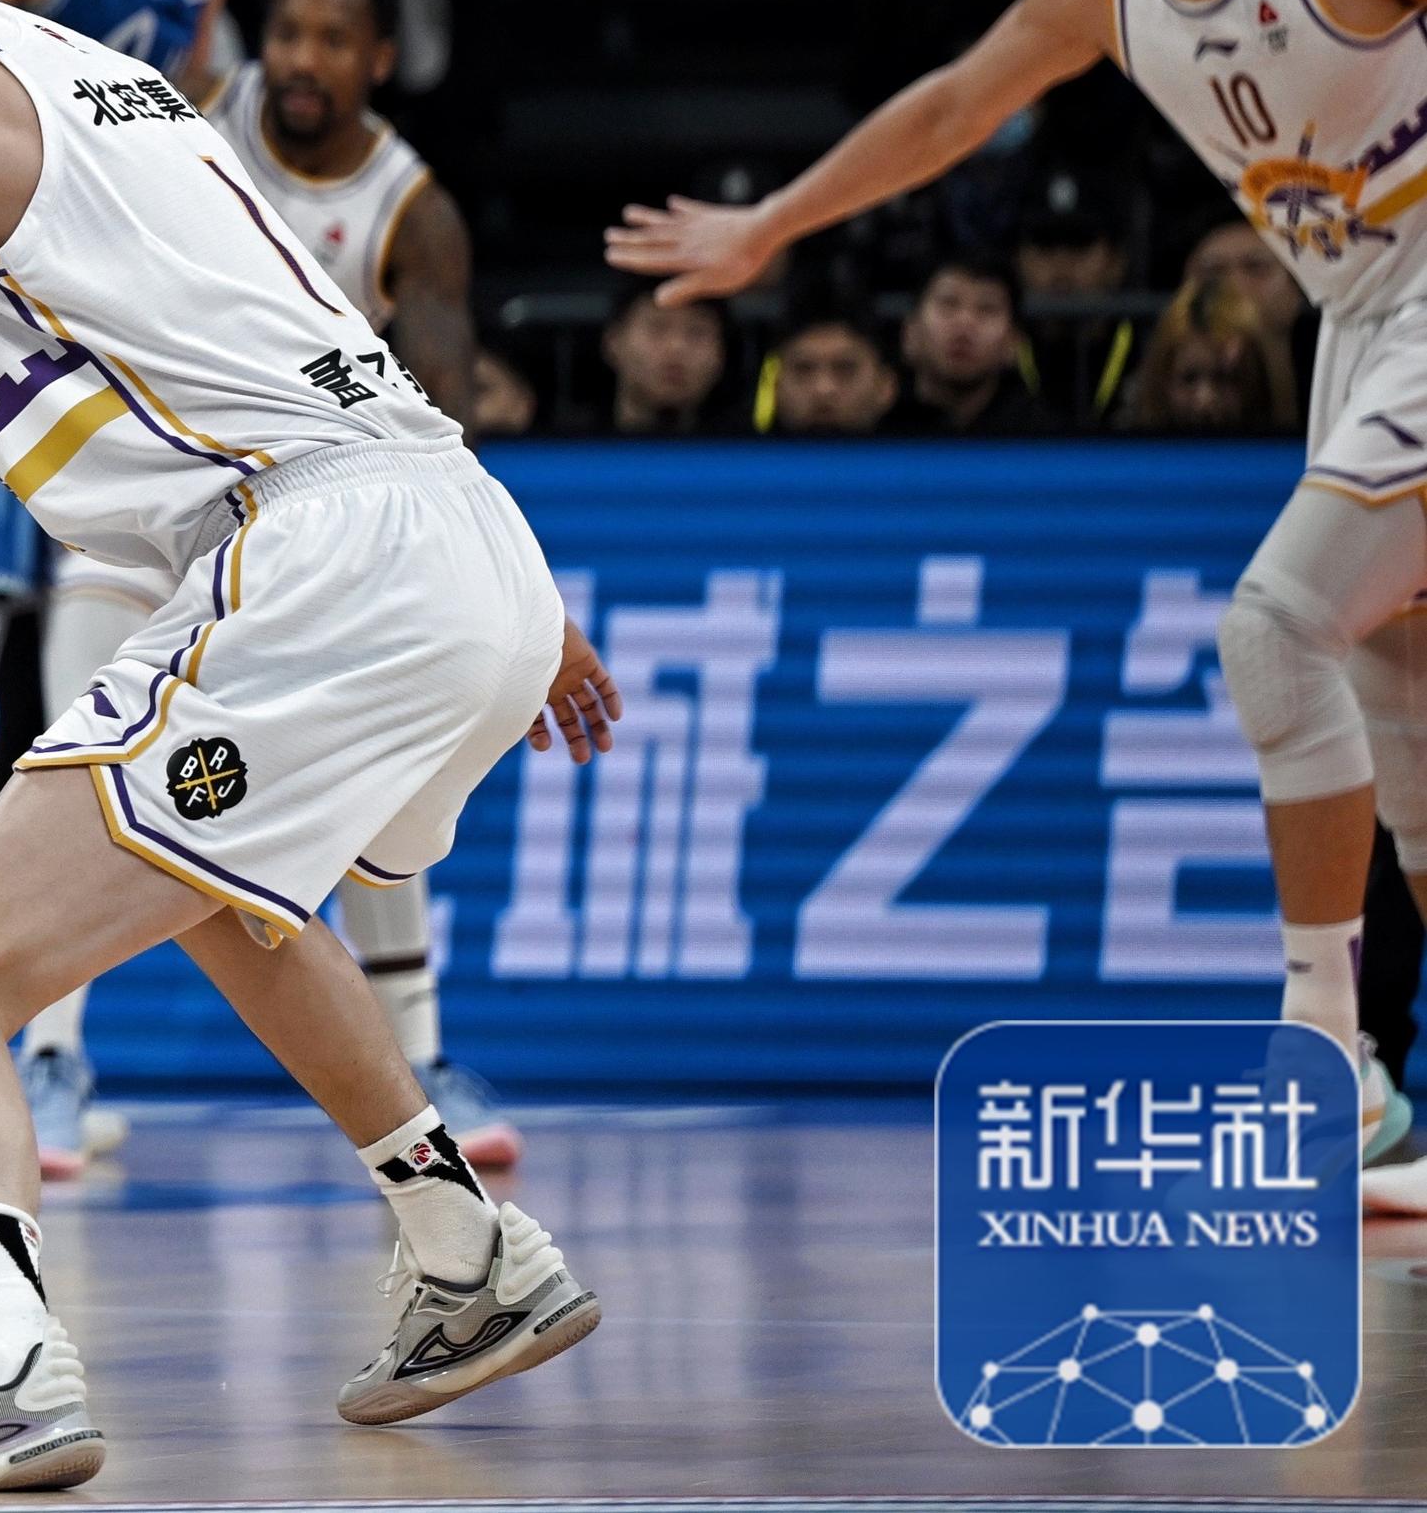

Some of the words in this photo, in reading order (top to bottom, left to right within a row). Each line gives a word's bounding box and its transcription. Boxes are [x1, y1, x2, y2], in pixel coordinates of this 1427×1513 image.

[72, 75, 202, 126] 北控集
[1208, 70, 1277, 148] 10
